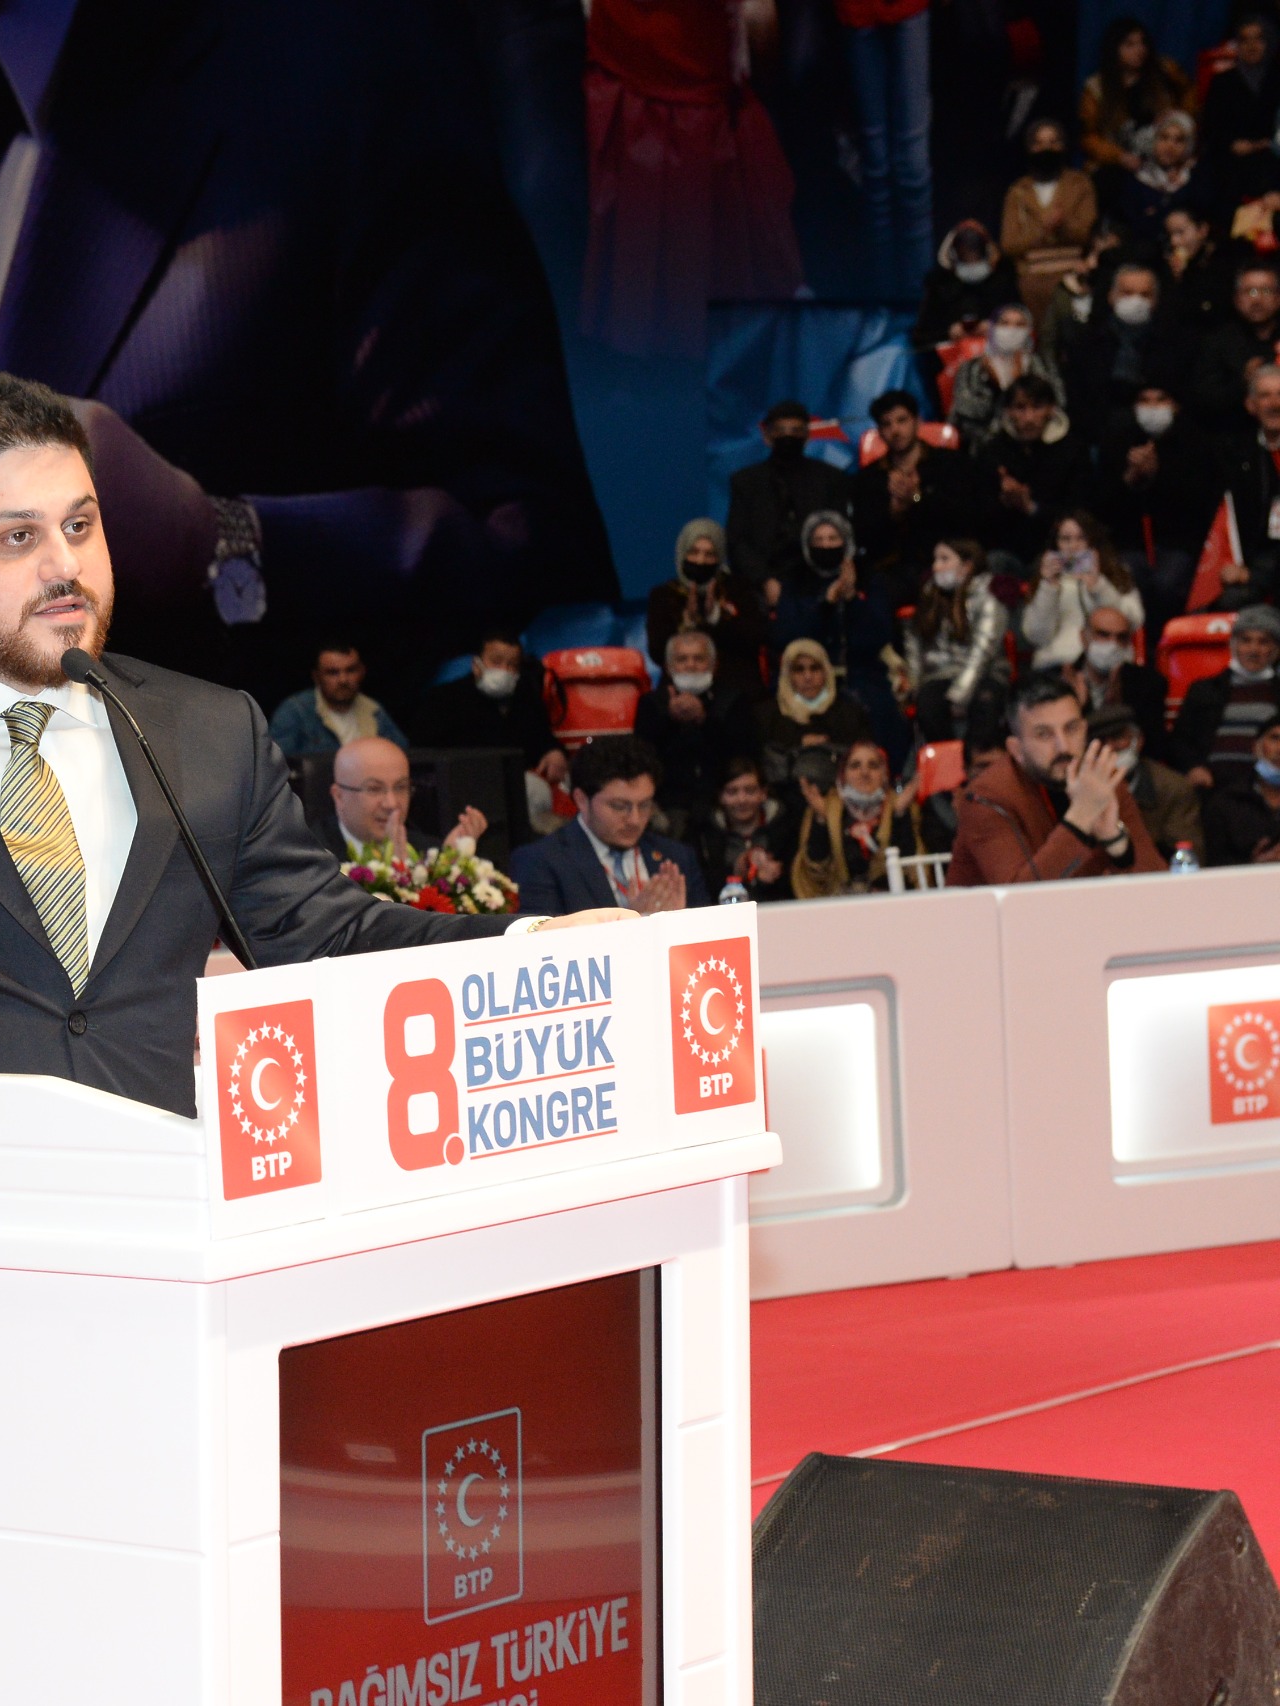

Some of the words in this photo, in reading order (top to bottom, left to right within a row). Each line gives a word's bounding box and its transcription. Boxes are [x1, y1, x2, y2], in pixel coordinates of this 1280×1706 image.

[462, 955, 612, 1021] OLAĞAN
[383, 977, 465, 1171] 8.
[464, 1015, 615, 1088] BÜYÜK
[467, 1081, 618, 1154] KONGRE
[699, 1073, 734, 1099] BTP
[1232, 1094, 1269, 1116] BTP
[251, 1150, 293, 1182] BTP
[454, 1567, 494, 1600] BTP
[490, 1596, 629, 1688] TÜRKİYE
